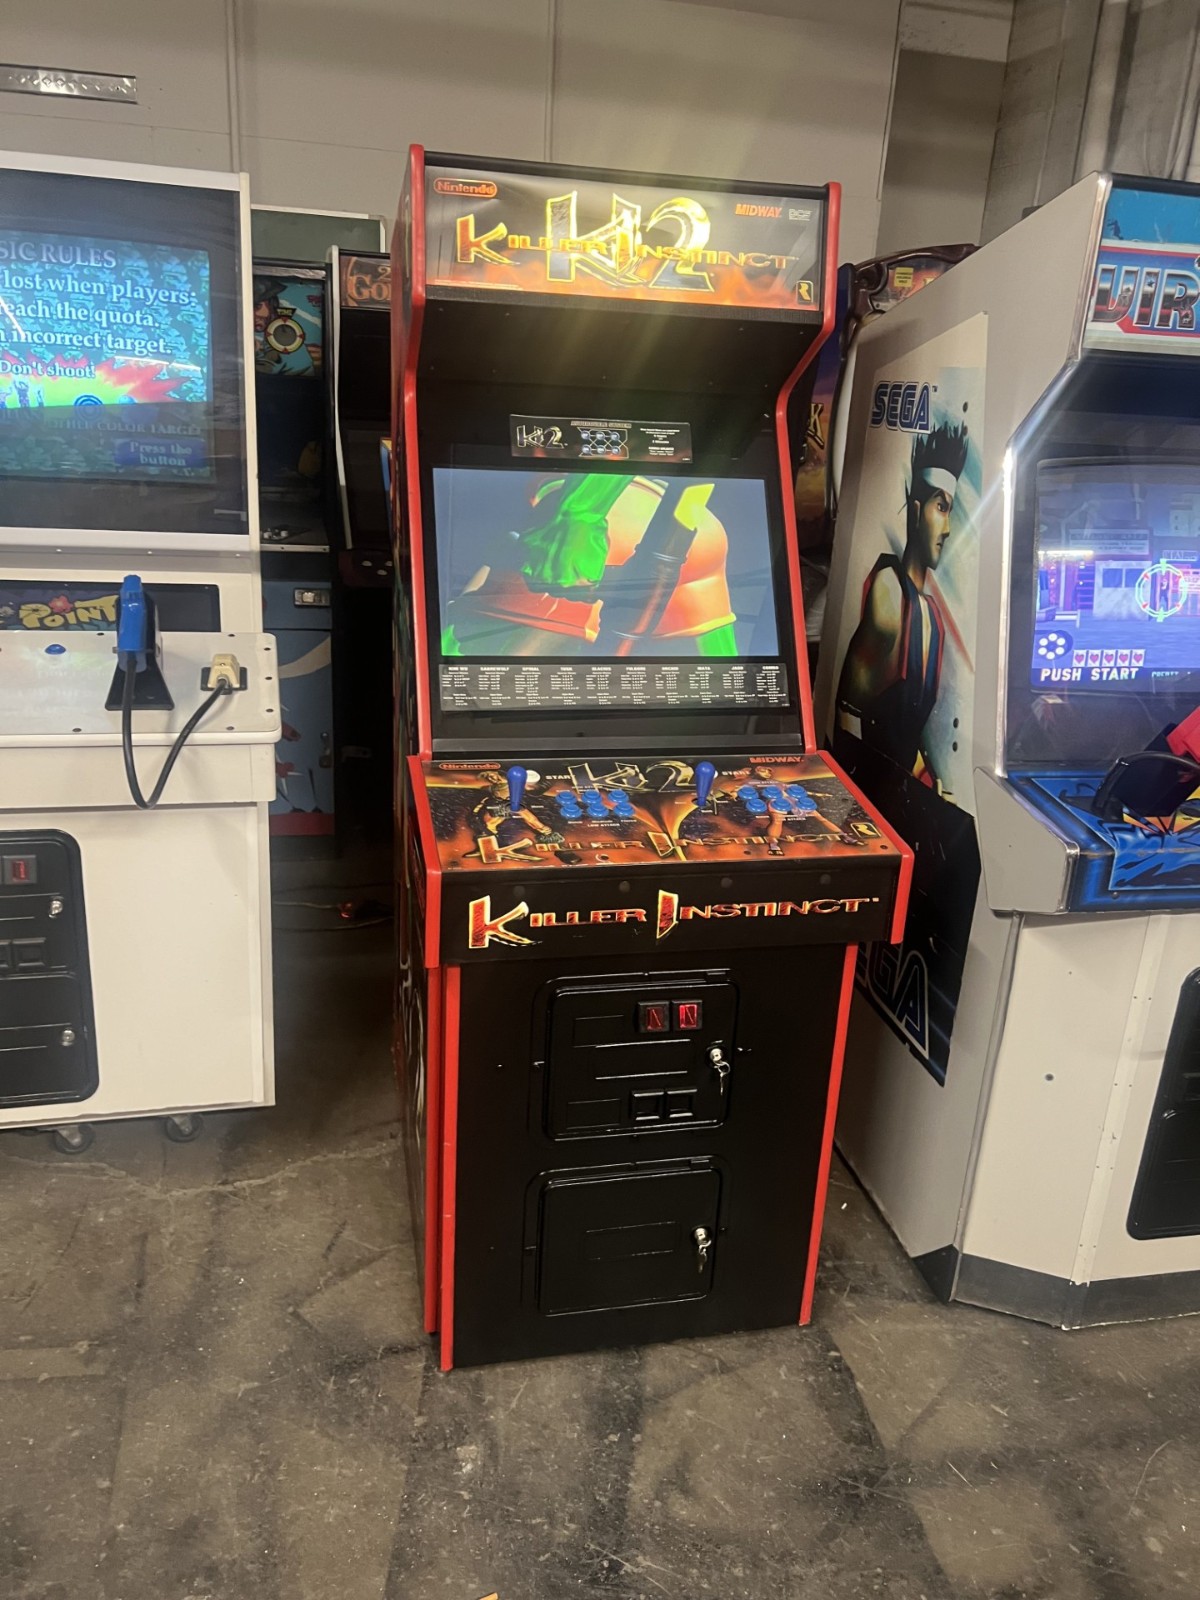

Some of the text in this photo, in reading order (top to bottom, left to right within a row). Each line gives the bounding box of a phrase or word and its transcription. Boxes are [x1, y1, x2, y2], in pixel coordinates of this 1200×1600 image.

[437, 181, 495, 195] Nintendo
[735, 203, 783, 218] MIDWAY
[41, 243, 117, 268] RULES
[457, 214, 797, 273] KILLER INSTINCT
[3, 269, 197, 305] lost when players:
[56, 301, 92, 321] the
[94, 311, 160, 329] quota.
[11, 328, 101, 347] incorrect
[106, 334, 172, 356] target.
[47, 363, 96, 378] shoot!
[870, 380, 931, 433] SEGA
[130, 441, 166, 454] Press
[140, 453, 187, 467] button
[1040, 667, 1139, 682] PUSH START
[469, 889, 870, 948] KILLER INSTINCT
